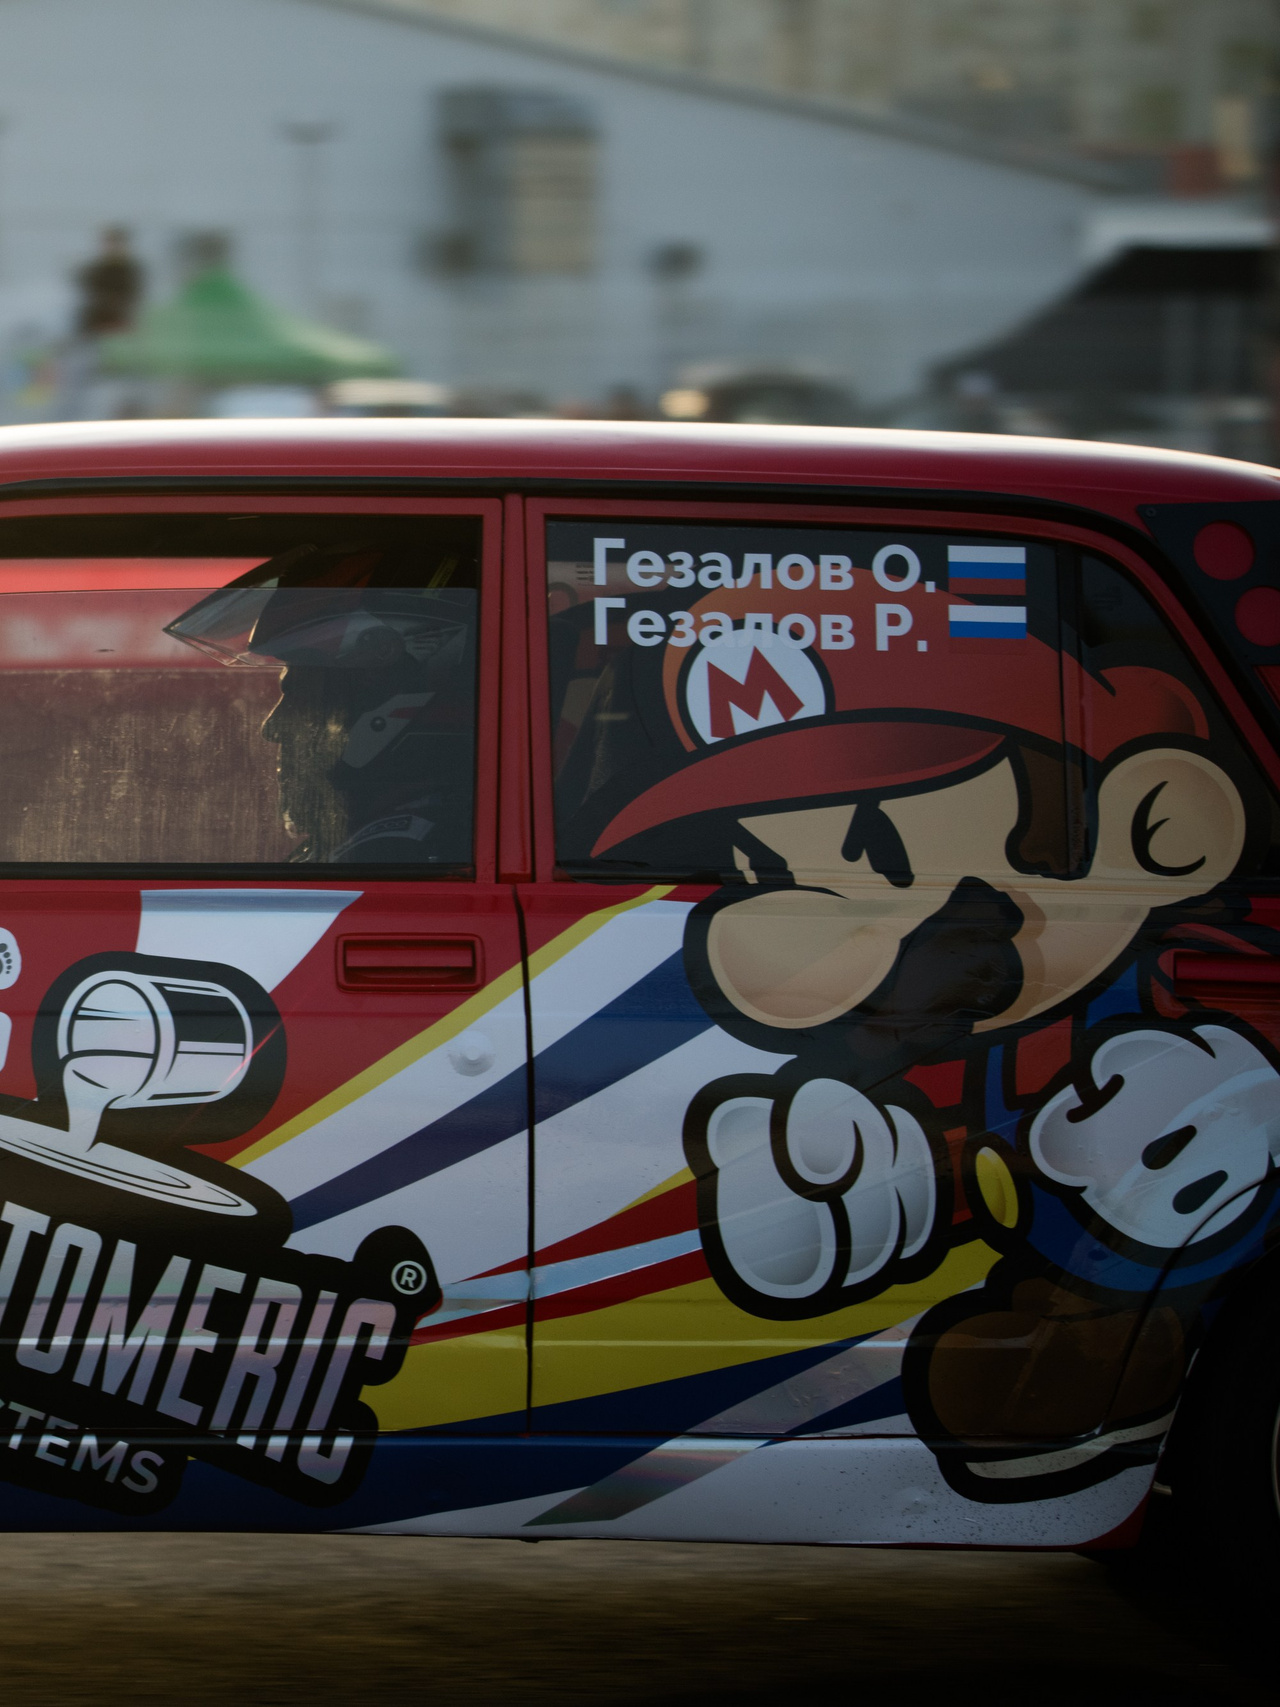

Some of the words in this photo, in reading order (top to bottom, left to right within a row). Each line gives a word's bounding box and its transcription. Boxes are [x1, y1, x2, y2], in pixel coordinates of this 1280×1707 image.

[593, 537, 855, 591] Гезалов
[871, 543, 936, 593] О.
[594, 597, 856, 651] Гезалов
[875, 602, 928, 652] Р.
